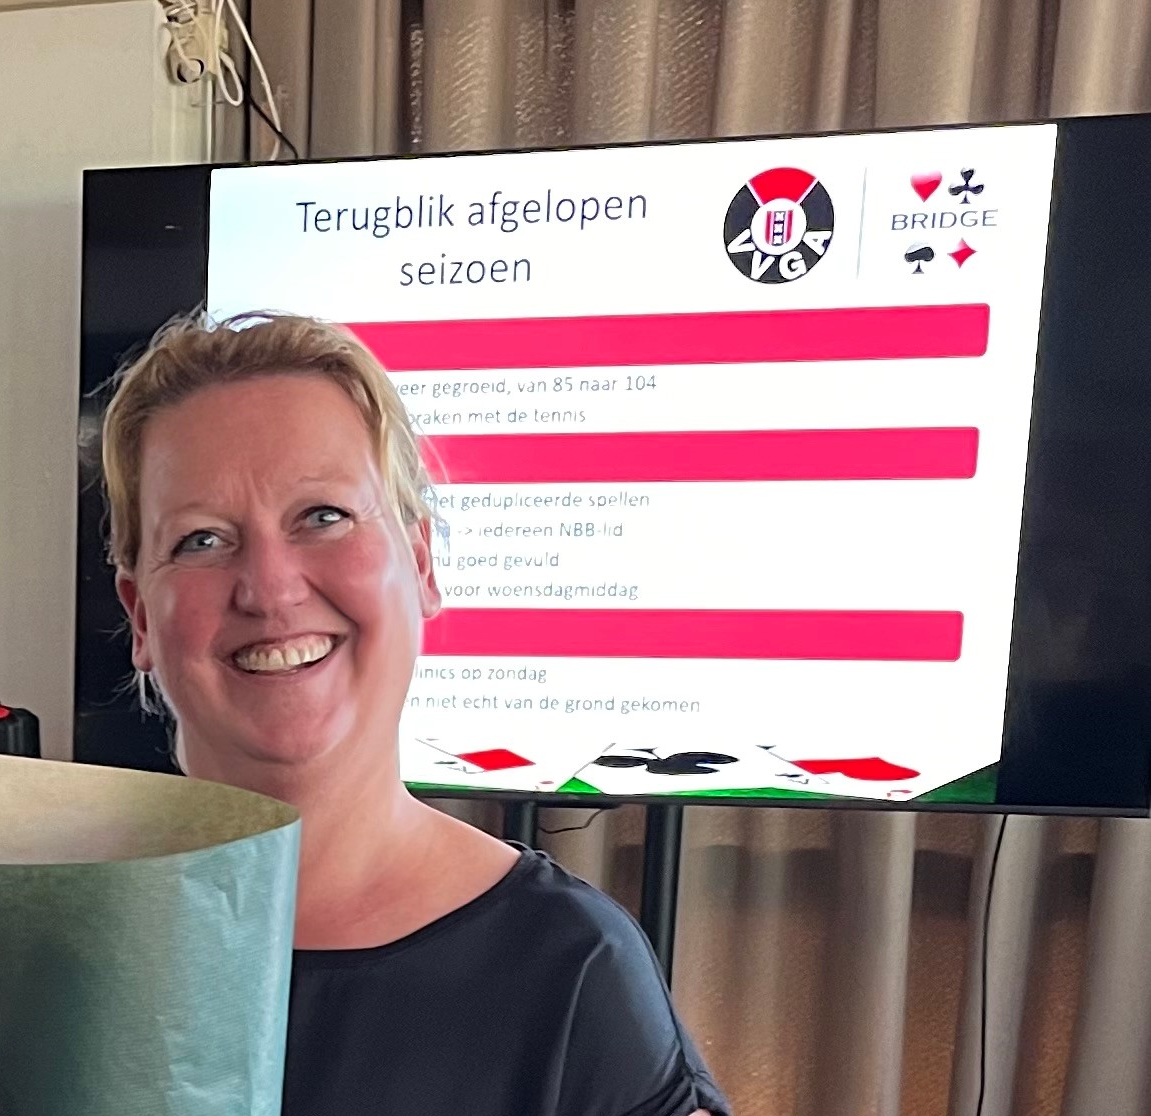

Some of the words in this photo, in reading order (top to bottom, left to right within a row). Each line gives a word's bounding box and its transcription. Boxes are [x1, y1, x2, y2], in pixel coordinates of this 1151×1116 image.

[296, 193, 455, 238] Terugblik
[467, 189, 647, 233] afgelopen
[890, 208, 999, 231] BRIDGE
[727, 228, 832, 281] VVGA
[400, 253, 531, 287] seizoen
[432, 378, 511, 399] gegroeid,
[517, 380, 547, 394] van
[553, 376, 573, 392] 85
[579, 379, 619, 392] naar
[625, 375, 657, 391] 104
[467, 409, 501, 424] met
[507, 408, 528, 423] de
[534, 408, 587, 423] tennis
[461, 492, 582, 511] gedupliceerde
[588, 491, 650, 508] spellen
[478, 522, 553, 538] iedereen
[559, 522, 624, 537] NBB-lid
[457, 552, 498, 571] goed
[503, 552, 560, 571] gevuld
[445, 584, 481, 597] voor
[487, 582, 639, 601] woensdagmiddag
[461, 667, 482, 681] op
[487, 666, 548, 684] zondag
[426, 695, 457, 709] niet
[462, 695, 499, 709] echt
[504, 697, 533, 710] van
[539, 696, 560, 711] de
[564, 697, 615, 714] grond
[620, 698, 701, 715] gekomen
